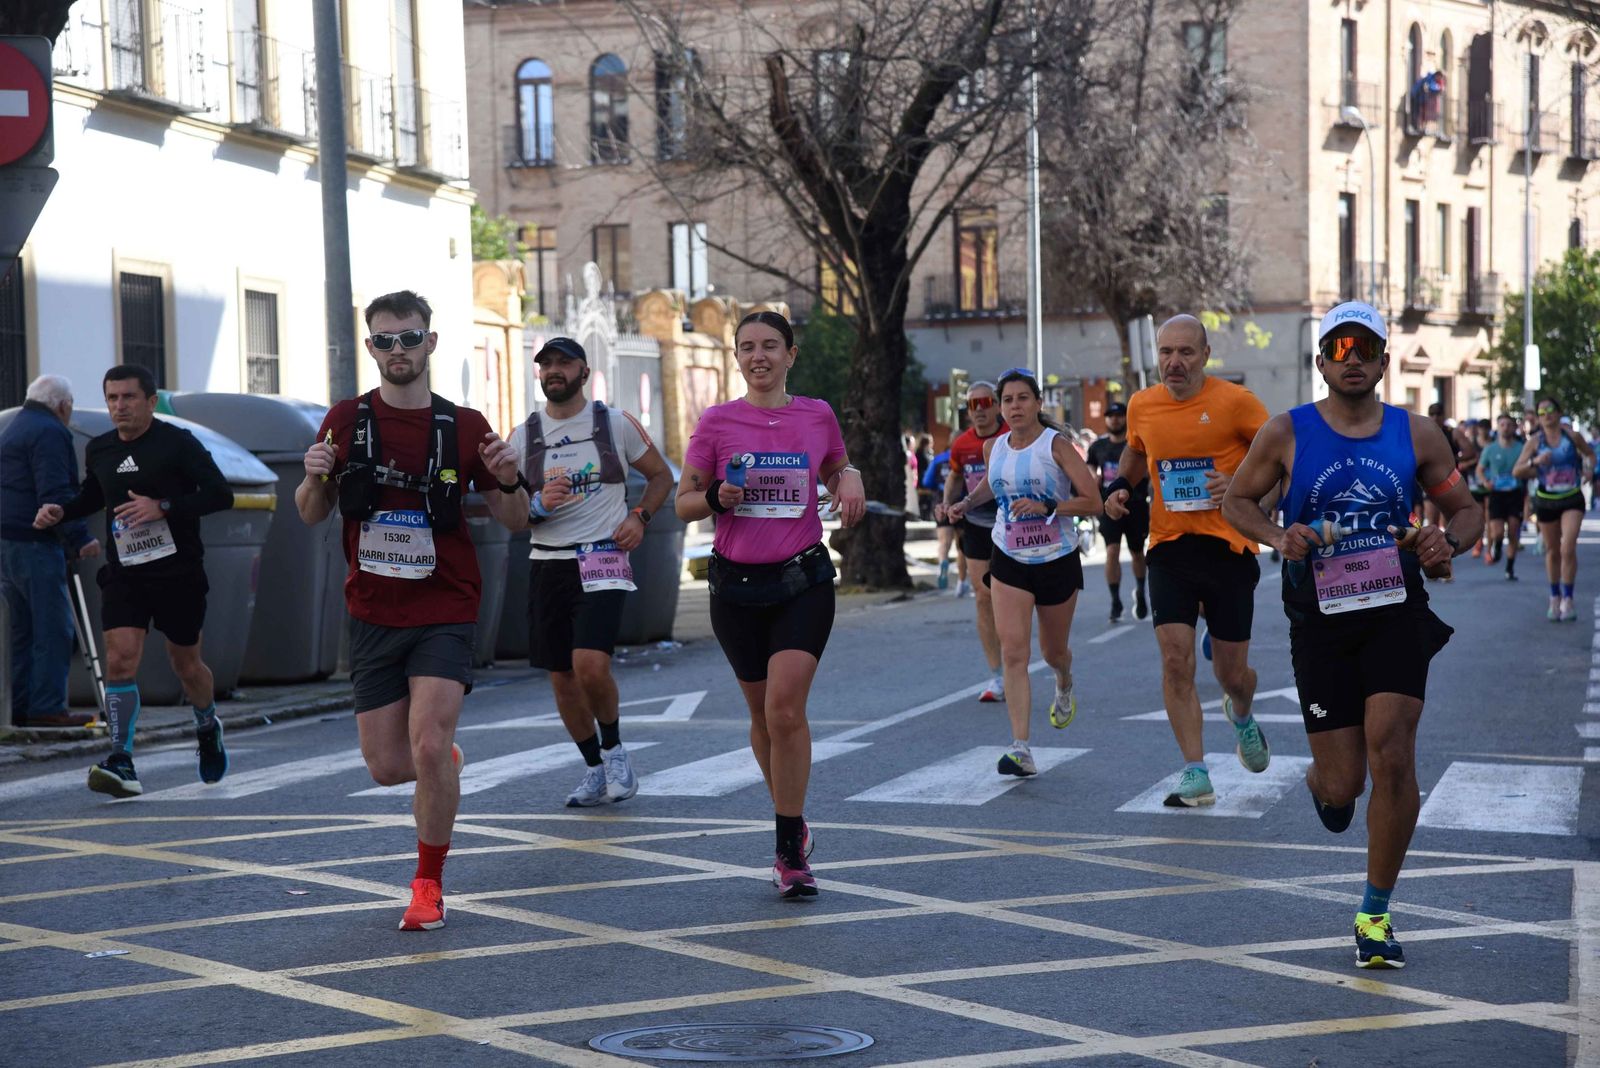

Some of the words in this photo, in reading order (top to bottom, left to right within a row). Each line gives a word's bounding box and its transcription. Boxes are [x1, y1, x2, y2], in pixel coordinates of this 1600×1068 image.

[1335, 310, 1373, 323] HOKA
[760, 456, 800, 465] ZURICH
[1175, 461, 1207, 469] ZURICH
[116, 465, 139, 473] adidas
[759, 476, 785, 485] 10105
[1310, 461, 1342, 504] RUNNING
[1346, 458, 1354, 466] &
[1360, 457, 1404, 502] TRIATHLON
[743, 488, 800, 502] ESTELLE
[1174, 487, 1201, 499] FRED
[385, 513, 424, 525] ZURICH
[125, 535, 165, 554] JUANDE
[383, 532, 411, 544] 15302
[1016, 534, 1051, 547] FLAVIA
[1340, 535, 1387, 552] ZURICH
[359, 549, 385, 561] HARRI
[387, 552, 435, 565] STALLARD
[1344, 560, 1370, 573] 9883
[581, 569, 604, 580] VIRG
[606, 567, 620, 577] OLI
[1318, 582, 1358, 599] PIERRE
[1361, 576, 1404, 592] KABEYA
